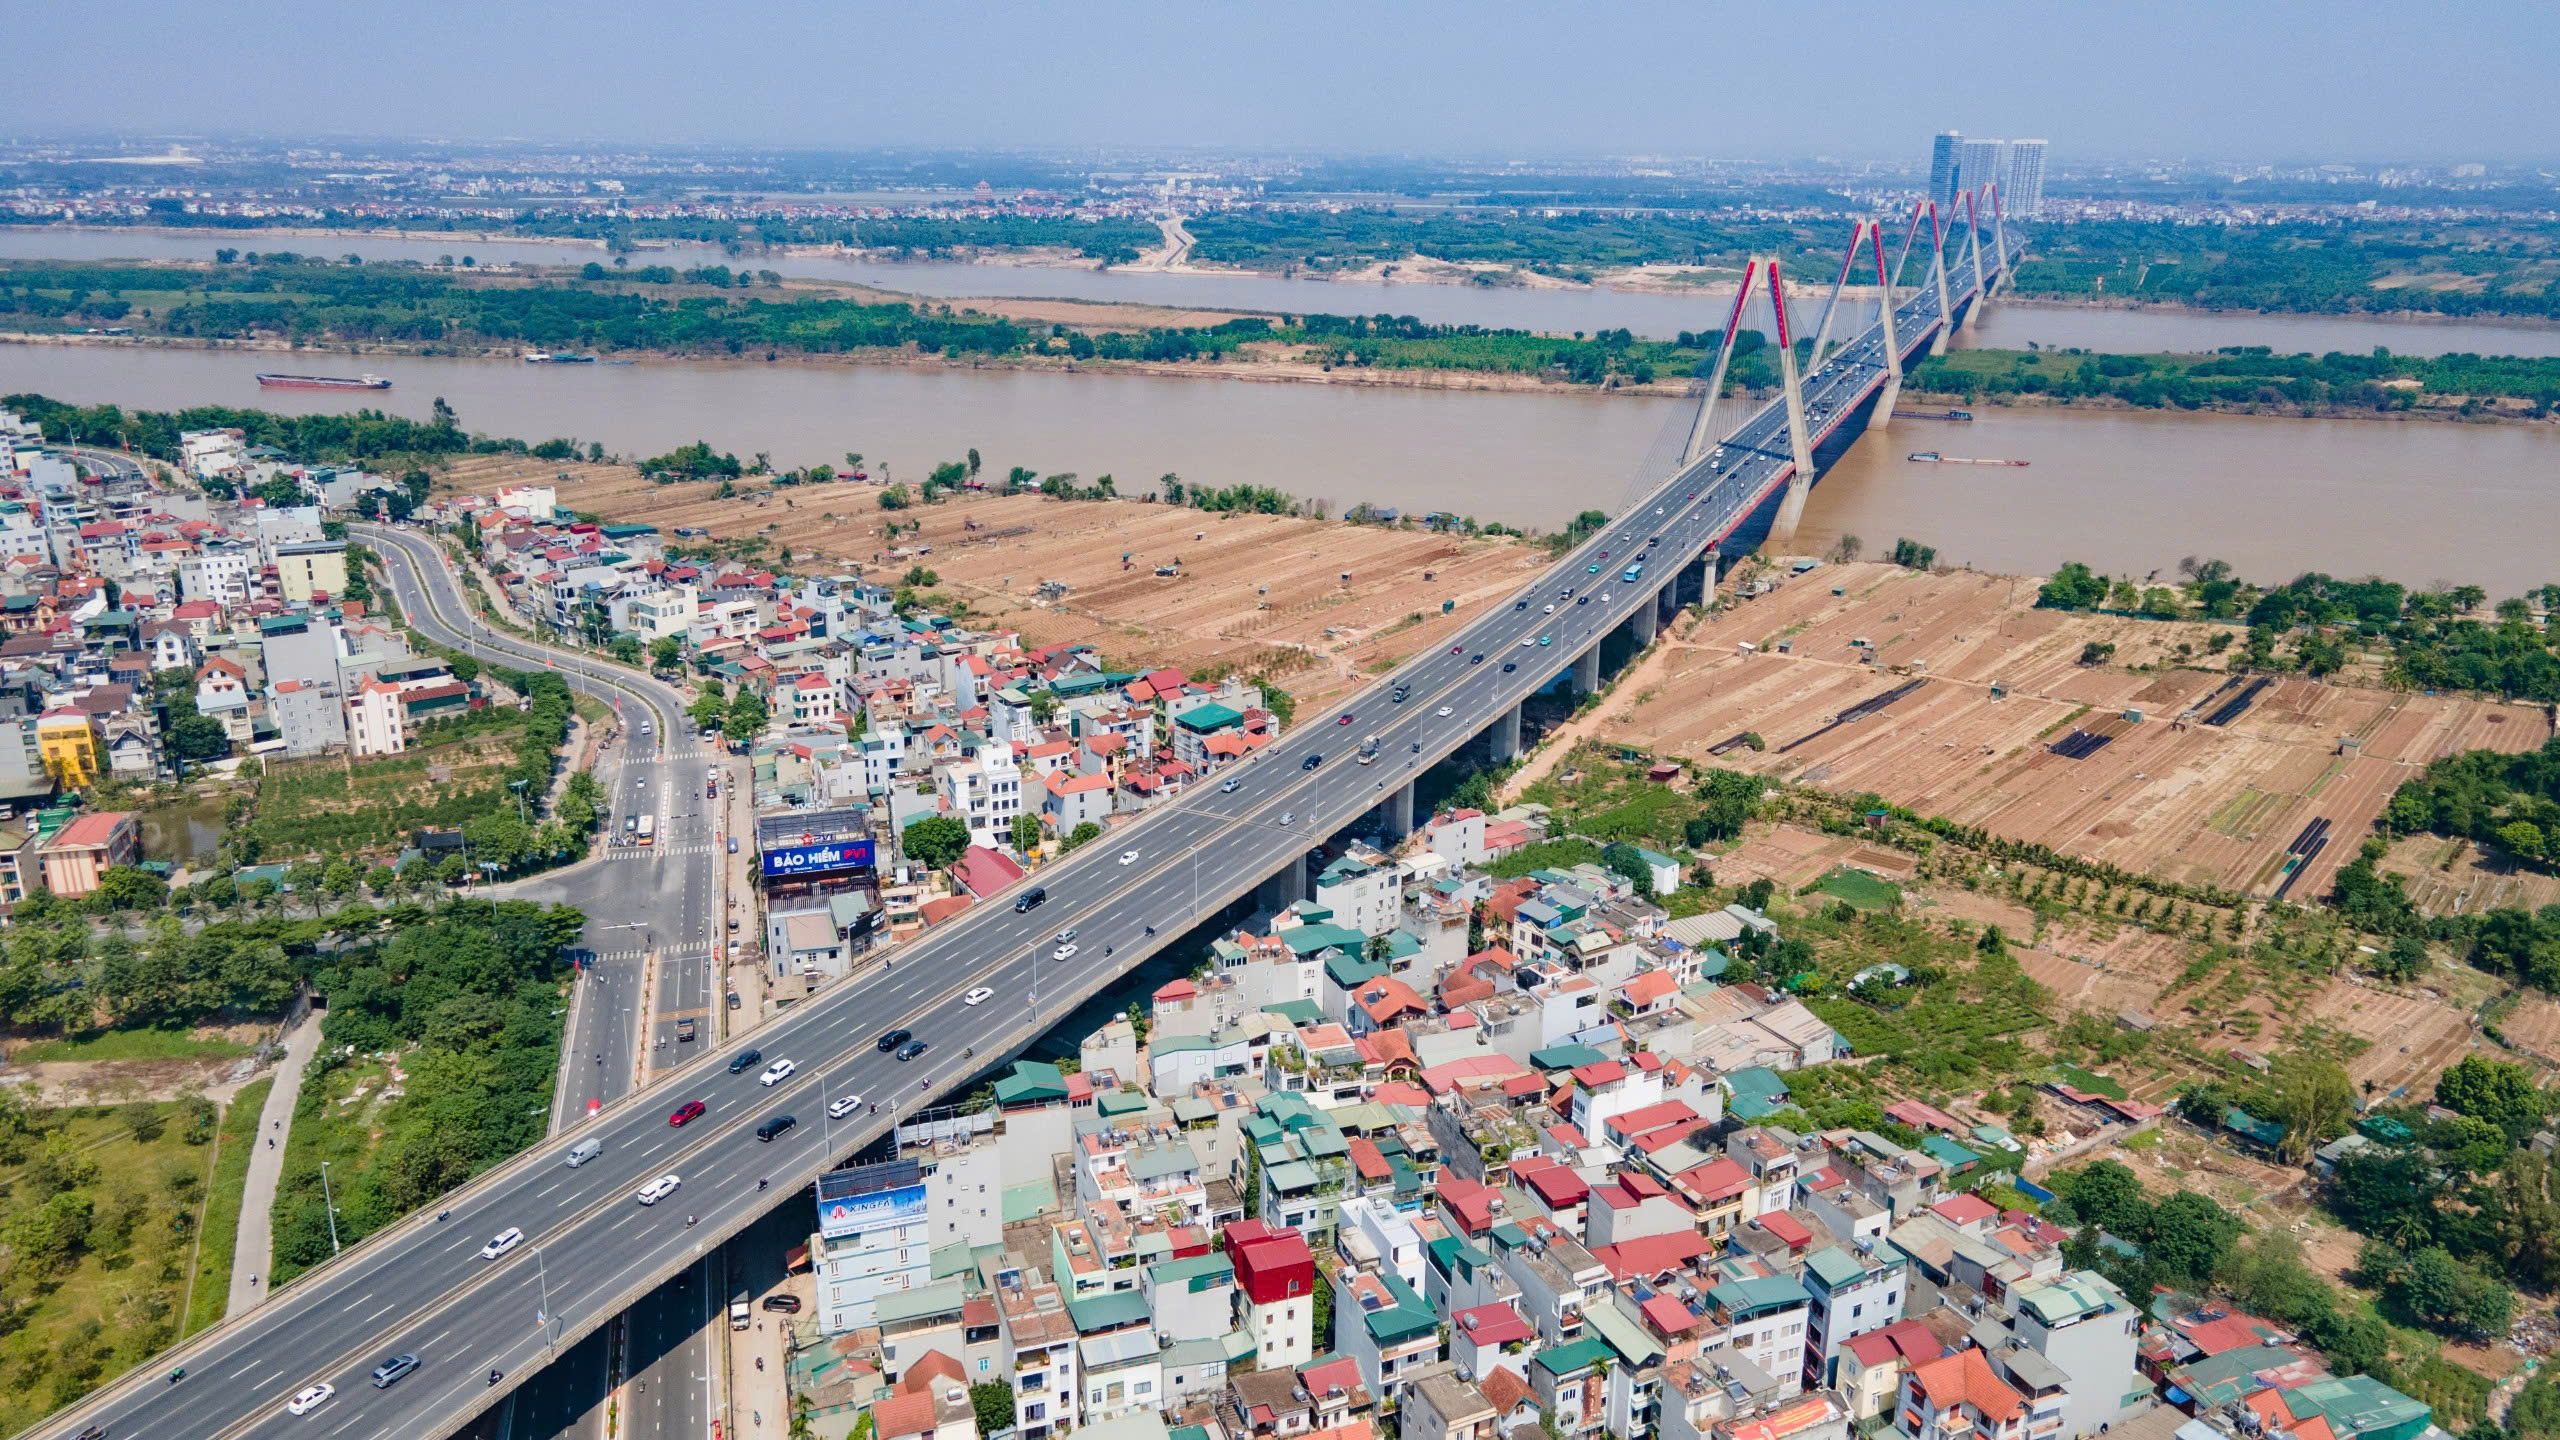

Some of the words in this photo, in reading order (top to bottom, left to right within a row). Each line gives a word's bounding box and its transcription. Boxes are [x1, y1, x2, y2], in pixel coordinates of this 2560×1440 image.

[774, 852, 804, 867] BẢO
[808, 846, 840, 864] HIỂM
[844, 848, 866, 860] PVI
[850, 1200, 890, 1212] XINGFA
